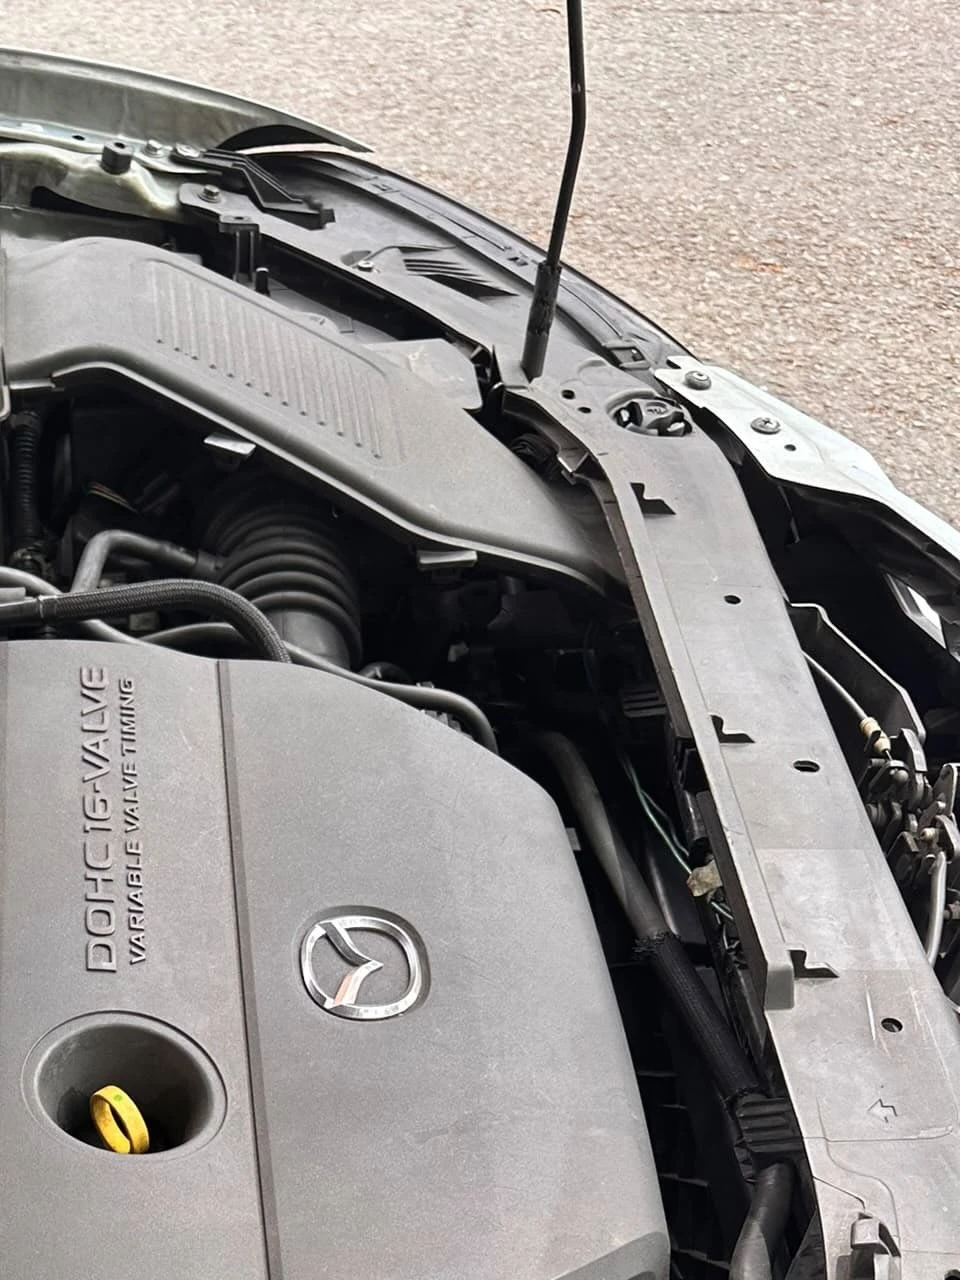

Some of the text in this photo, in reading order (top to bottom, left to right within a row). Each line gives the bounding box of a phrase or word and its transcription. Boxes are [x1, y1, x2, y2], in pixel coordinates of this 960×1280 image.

[80, 664, 117, 974] DOHC 16-VALVE
[118, 678, 147, 966] VARIABLE VALVE TIMING
